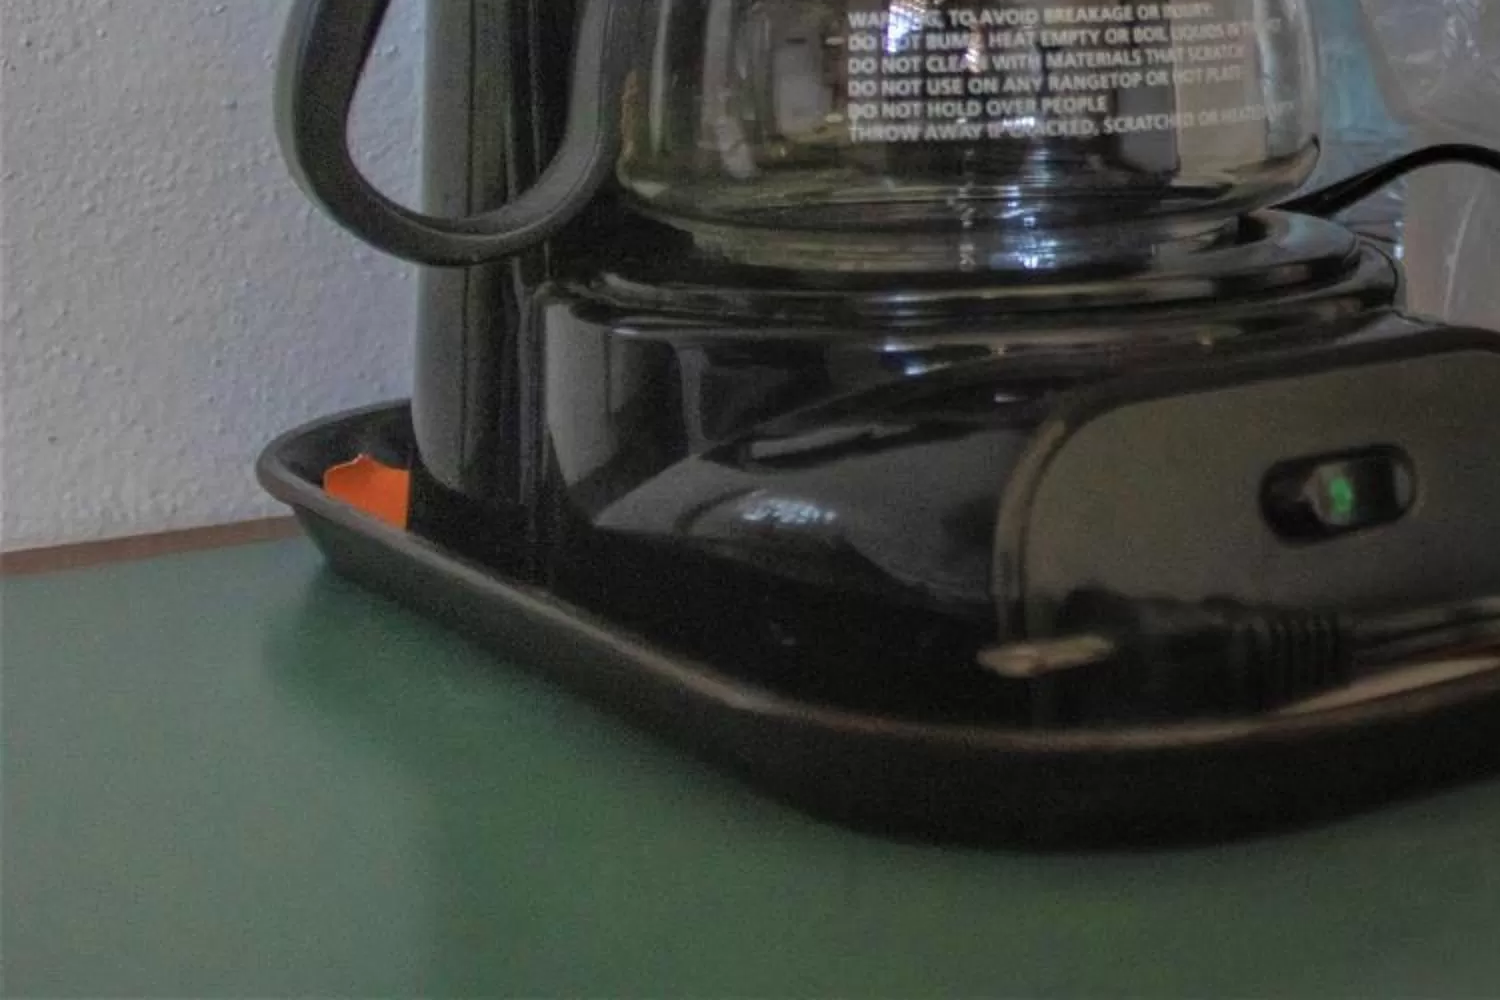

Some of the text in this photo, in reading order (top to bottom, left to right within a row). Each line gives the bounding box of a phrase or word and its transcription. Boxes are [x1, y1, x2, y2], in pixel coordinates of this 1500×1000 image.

[948, 8, 975, 27] TO
[980, 7, 1040, 26] AVOID
[1044, 4, 1134, 23] BREAKAGE
[1137, 3, 1160, 21] OR
[848, 33, 877, 52] DO
[989, 30, 1035, 48] HEAT
[1040, 28, 1101, 47] EMPTY
[1105, 27, 1129, 45] OR
[1134, 25, 1169, 43] BOIL
[848, 56, 877, 74] DO
[882, 55, 921, 74] NOT
[992, 53, 1041, 71] WITH
[1046, 49, 1141, 69] MATERIALS
[848, 79, 877, 97] DO
[881, 78, 922, 97] NOT
[926, 76, 964, 95] USE
[968, 76, 999, 94] ON
[1003, 75, 1043, 93] ANY
[1049, 72, 1143, 92] RANGETOP
[1146, 70, 1169, 87] OR
[881, 101, 923, 119] NOT
[926, 99, 982, 118] HOLD
[986, 98, 1036, 116] OVER
[1041, 95, 1107, 114] PEOPLE
[924, 121, 983, 140] AWAY
